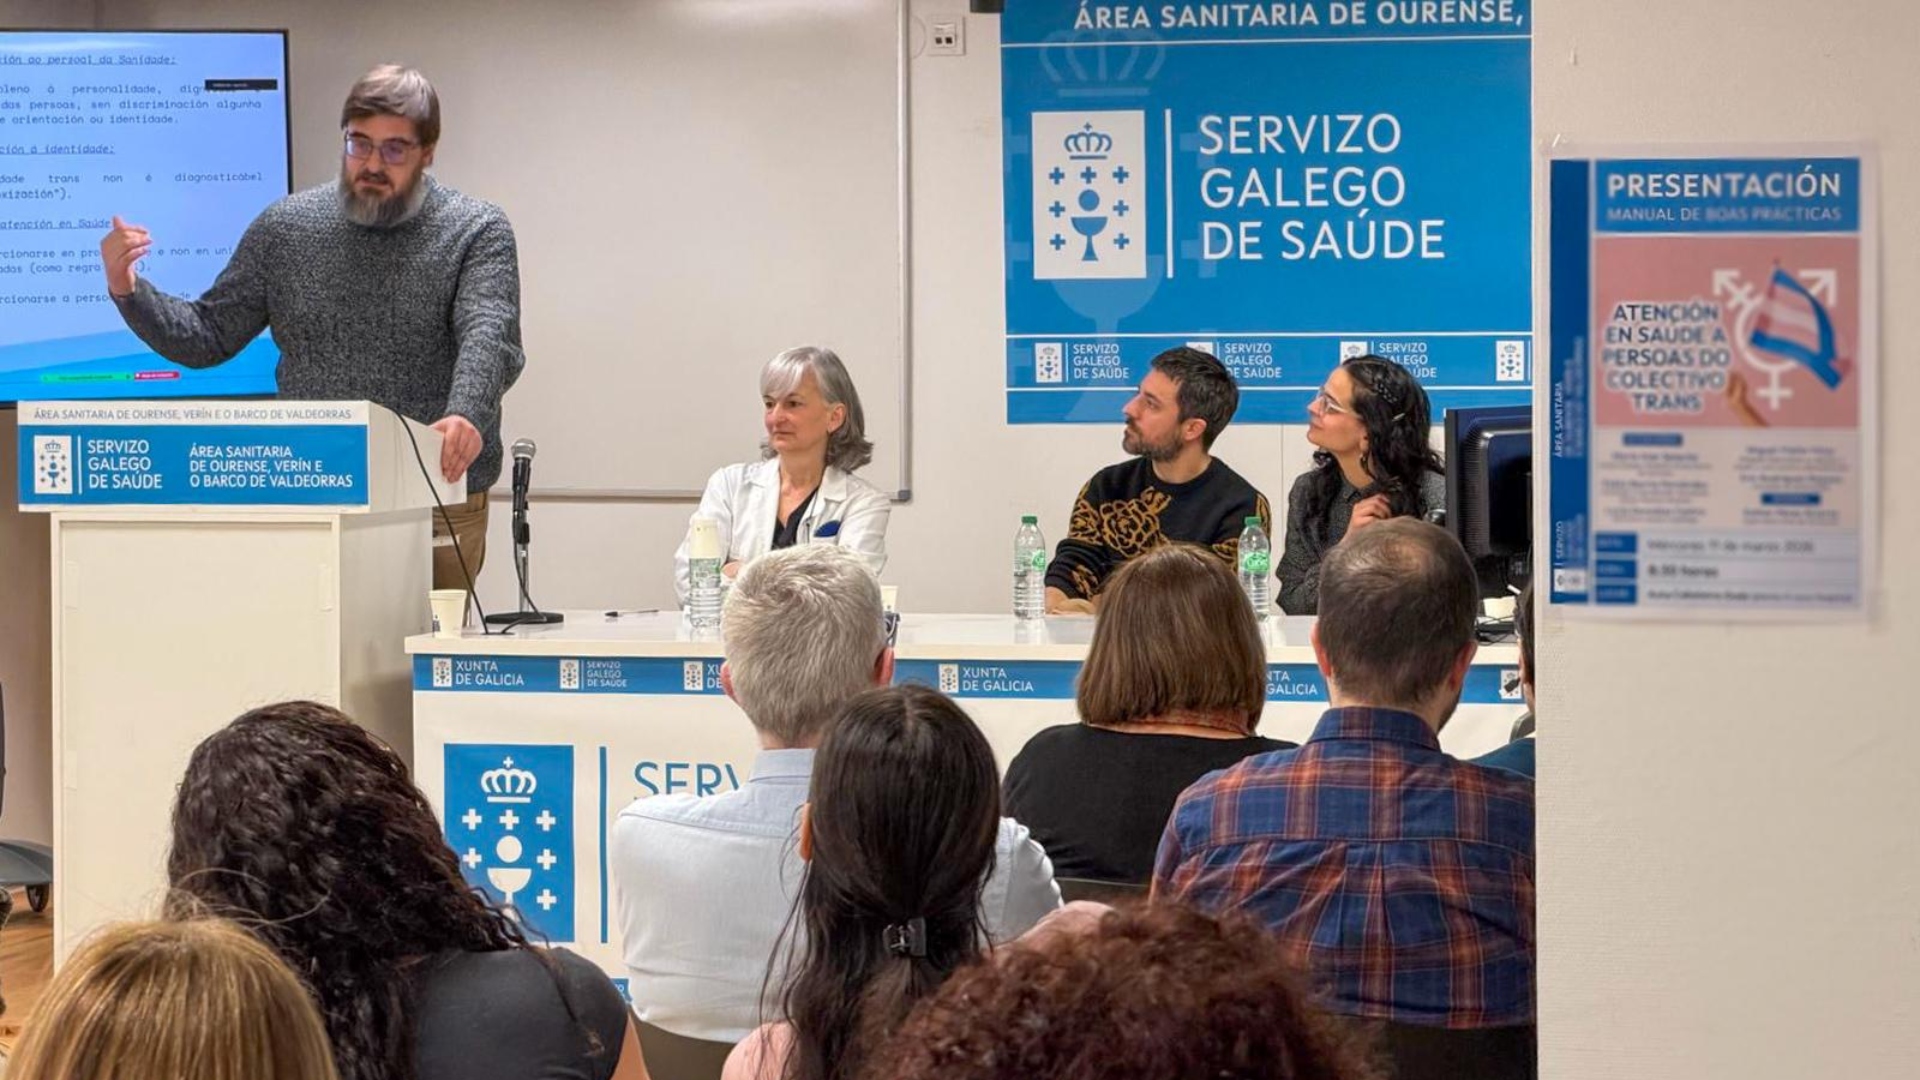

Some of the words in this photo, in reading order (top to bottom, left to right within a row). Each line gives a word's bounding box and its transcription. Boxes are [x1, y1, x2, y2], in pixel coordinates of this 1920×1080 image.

[1074, 1, 1151, 29] ÁREA
[1161, 3, 1319, 28] SANITARIA
[1330, 2, 1366, 25] DE
[1377, 0, 1524, 26] OURENSE,
[91, 101, 112, 109] sen
[119, 100, 209, 110] discriminación
[216, 100, 262, 111] algunha
[12, 115, 84, 124] orientación
[90, 116, 104, 124] ou
[1199, 112, 1400, 155] SERVIZO
[48, 174, 80, 183] trans
[103, 175, 123, 183] non
[1607, 165, 1841, 198] PRESENTACIÓN
[1200, 166, 1405, 209] GALEGO
[1607, 207, 1675, 221] MANUAL
[1680, 207, 1700, 221] DE
[1203, 221, 1263, 260] DE
[1281, 208, 1446, 260] SAÚDE
[170, 248, 191, 256] non
[1613, 301, 1719, 321] ATENCIÓN
[1605, 326, 1632, 343] EN
[1712, 326, 1726, 342] A
[1073, 343, 1119, 355] SERVIZO
[1224, 342, 1272, 354] SERVIZO
[1379, 342, 1428, 353] SERVIZO
[1073, 355, 1121, 367] GALEGO
[1225, 354, 1273, 366] GALEGO
[1384, 354, 1429, 365] ALEGO
[1603, 348, 1694, 367] PERSOAS
[1699, 348, 1731, 367] DO
[1074, 367, 1089, 379] DE
[1092, 364, 1130, 379] SAÚDE
[1606, 371, 1726, 389] COLECTIVO
[1633, 393, 1702, 411] TRANS
[34, 408, 59, 420] ÁREA
[62, 410, 114, 420] SANITARIA
[117, 410, 130, 419] DE
[183, 407, 212, 419] VERÍN
[215, 410, 221, 419] E
[223, 410, 231, 419] O
[234, 410, 267, 419] BARCO
[270, 410, 283, 419] DE
[286, 409, 352, 419] VALDEORRAS
[88, 439, 149, 454] SERVIZO
[189, 442, 223, 458] ÁREA
[226, 445, 293, 458] SANITARIA
[88, 457, 151, 471] GALEGO
[190, 460, 206, 473] DE
[210, 460, 271, 474] OURENSE,
[274, 457, 312, 473] VERÍN
[315, 460, 323, 473] E
[89, 474, 108, 489] DE
[112, 469, 163, 489] SAÚDE
[190, 475, 200, 488] O
[204, 475, 247, 488] BARCO
[250, 475, 266, 488] DE
[269, 475, 353, 488] VALDEORRAS
[456, 661, 498, 672] XUNTA
[587, 661, 621, 670] SERVIZO
[587, 670, 622, 680] GALEGO
[962, 667, 1008, 679] XUNTA
[456, 674, 471, 685] DE
[475, 674, 525, 686] GALICIA
[587, 679, 599, 687] DE
[962, 680, 979, 691] DE
[983, 680, 1034, 692] GALICIA
[1265, 683, 1318, 695] GALICIA
